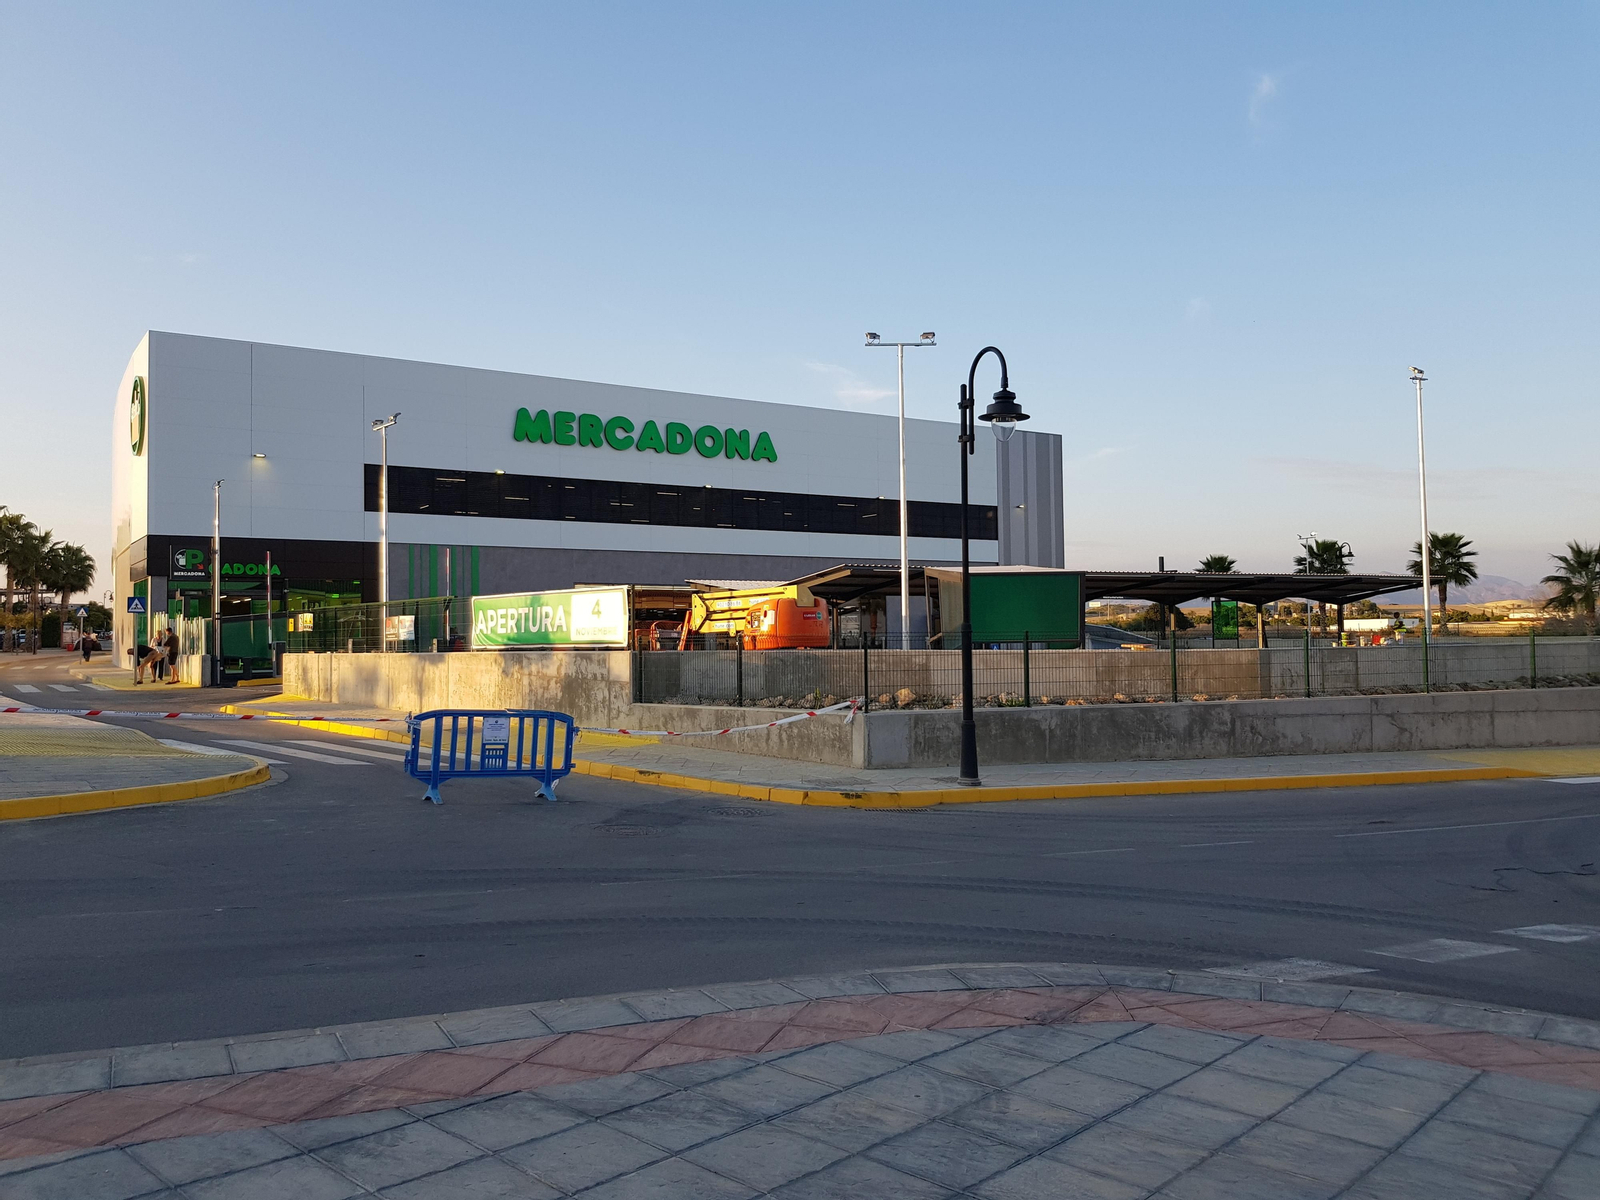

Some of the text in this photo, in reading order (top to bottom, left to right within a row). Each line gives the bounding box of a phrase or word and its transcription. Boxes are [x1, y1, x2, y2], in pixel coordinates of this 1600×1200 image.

[513, 407, 778, 463] MERCADONA
[185, 549, 204, 570] P
[591, 599, 602, 619] 4
[476, 605, 567, 635] APERTURA
[575, 626, 618, 636] NOVIEMBRE
